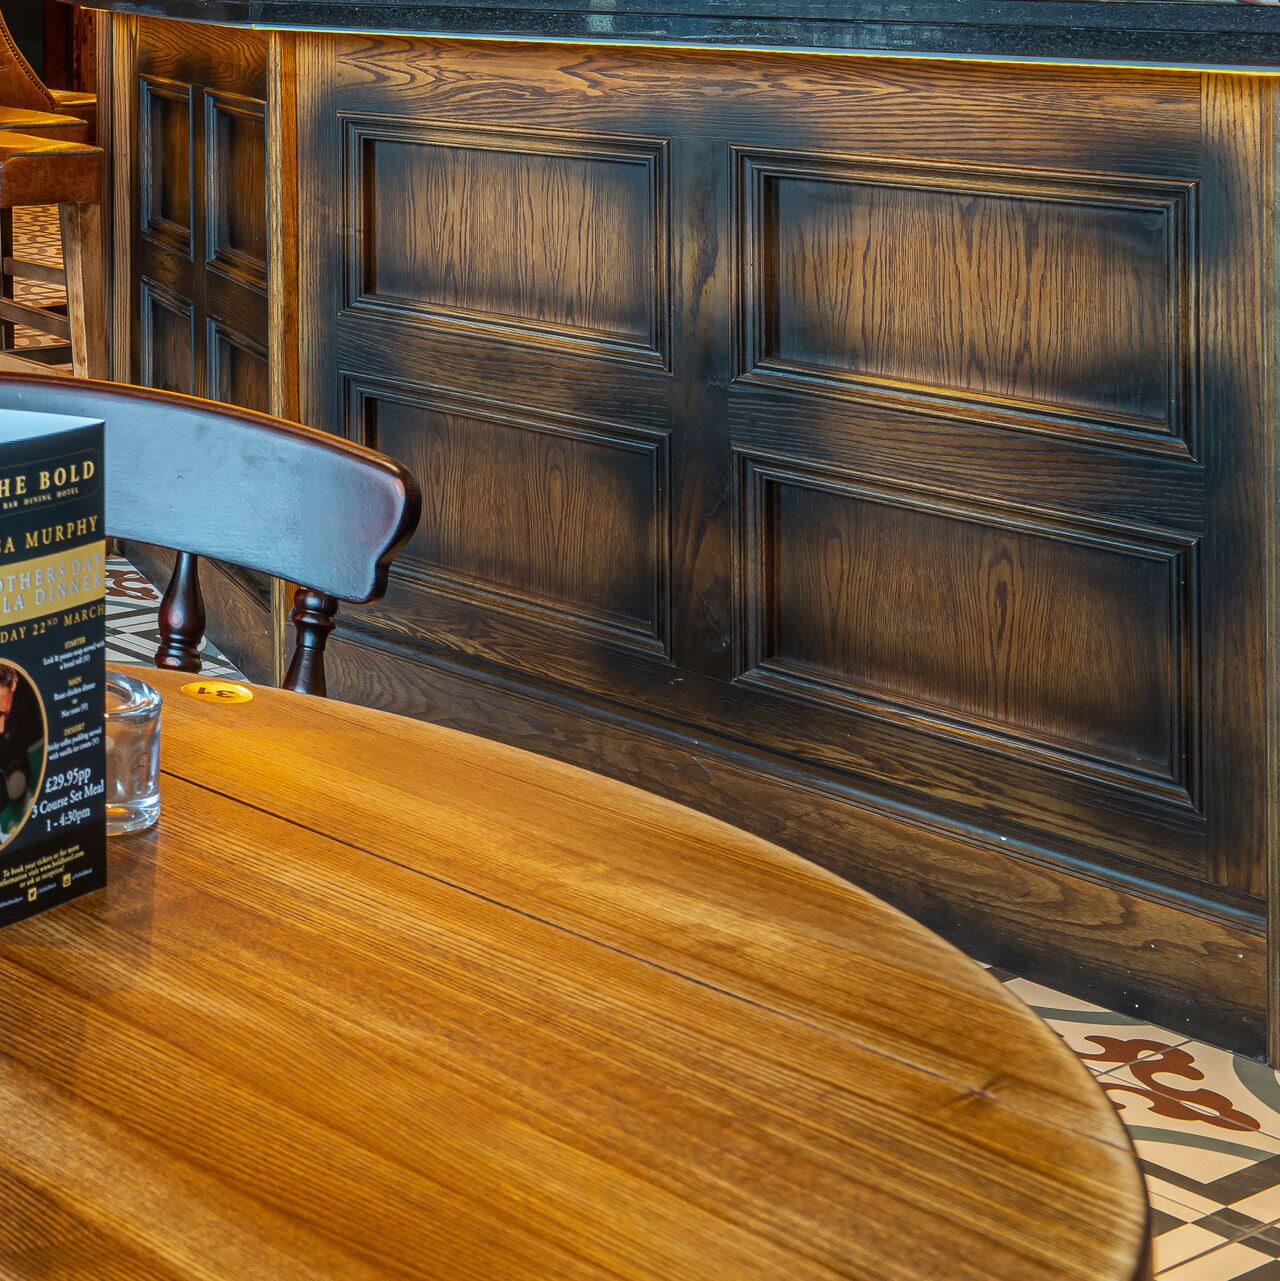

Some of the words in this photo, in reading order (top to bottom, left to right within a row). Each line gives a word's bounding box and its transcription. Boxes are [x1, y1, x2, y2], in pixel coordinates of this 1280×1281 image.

[39, 460, 95, 490] BOLD
[2, 500, 19, 510] BAR
[23, 494, 52, 506] DINING
[56, 487, 79, 498] HOTEL
[25, 515, 98, 549] MURPHY
[72, 552, 102, 576] DAY
[35, 572, 102, 606] DINNER
[63, 604, 105, 627] MARCH
[64, 636, 86, 650] STARTER
[45, 768, 91, 793] £29.95pp
[31, 805, 38, 818] 3
[39, 797, 68, 814] Course
[69, 789, 83, 803] Set
[84, 779, 105, 798] Meal
[46, 819, 51, 832] 1
[59, 807, 91, 826] 4:30pm
[2, 870, 10, 878] To
[11, 865, 24, 876] book
